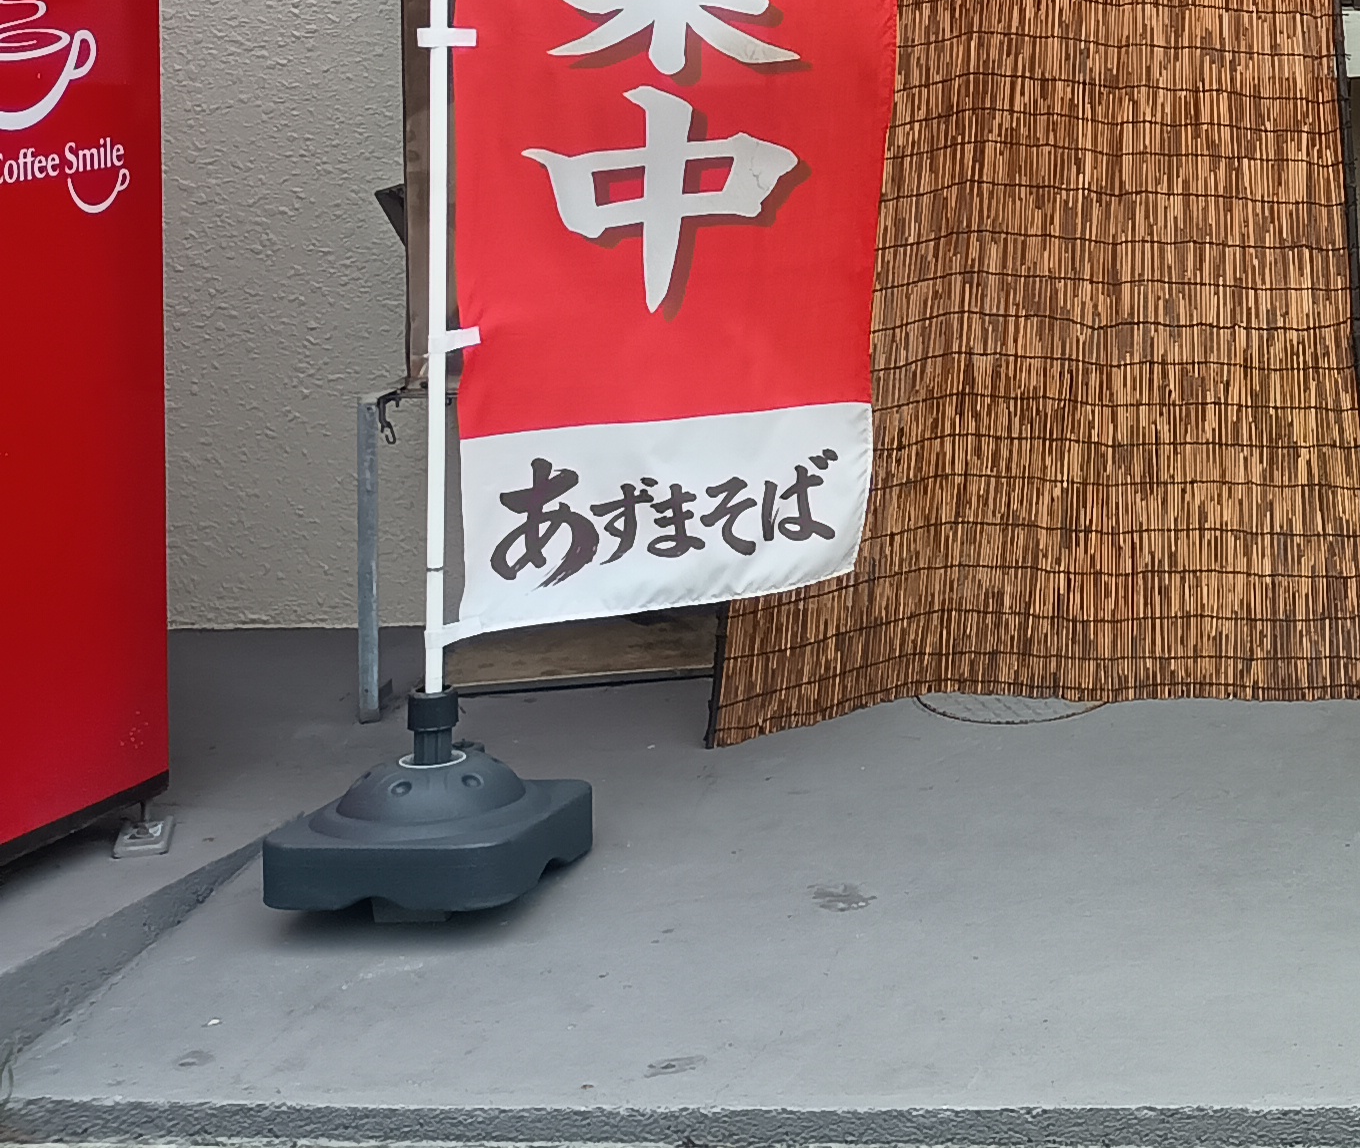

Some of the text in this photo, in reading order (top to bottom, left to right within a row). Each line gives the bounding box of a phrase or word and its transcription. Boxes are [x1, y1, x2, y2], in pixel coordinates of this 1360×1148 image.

[64, 137, 125, 175] Smile
[490, 448, 840, 590] あずまそば
